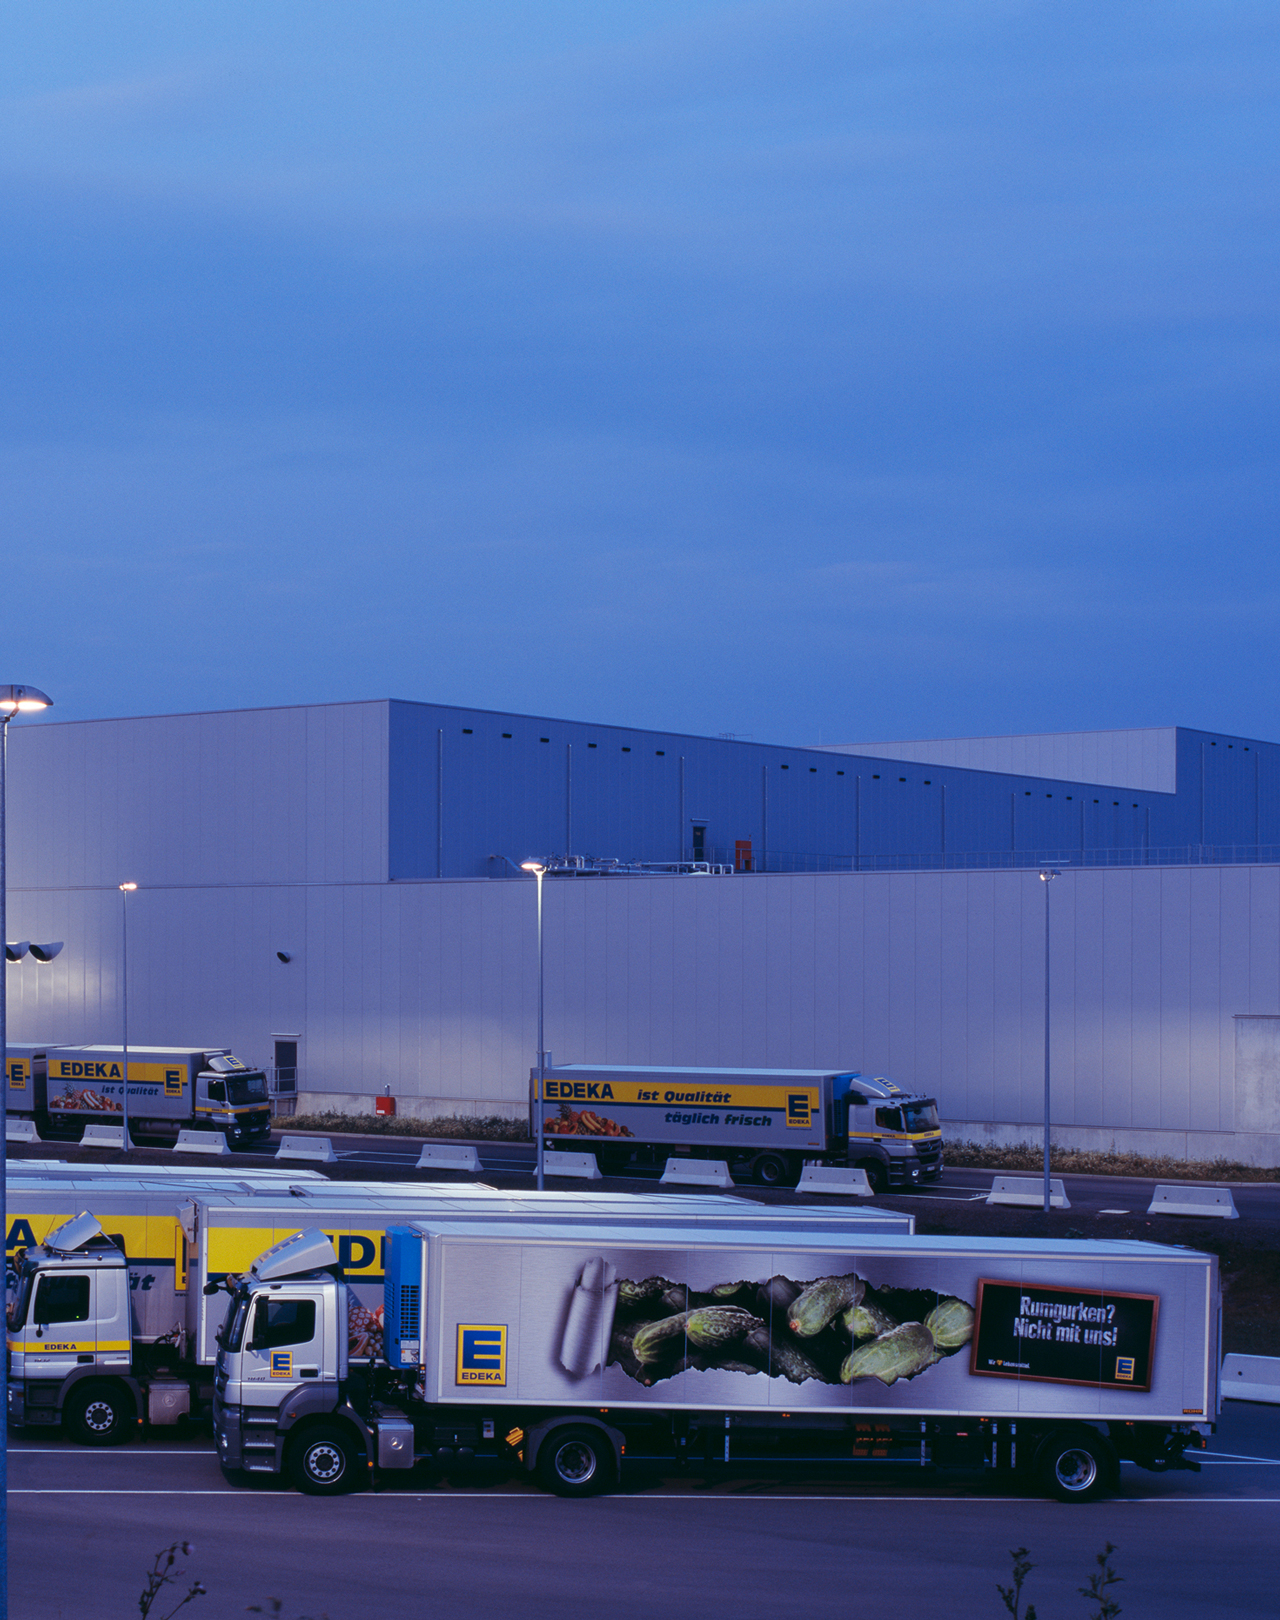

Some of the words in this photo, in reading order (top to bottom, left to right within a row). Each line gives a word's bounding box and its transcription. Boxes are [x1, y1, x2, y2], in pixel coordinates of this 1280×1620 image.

[11, 1064, 23, 1081] E
[60, 1062, 122, 1078] EDEKA
[166, 1070, 180, 1088] E
[102, 1085, 116, 1094] ist
[545, 1082, 614, 1099] EDEKA
[637, 1089, 660, 1101] ist
[664, 1091, 732, 1103] Qualität
[788, 1094, 808, 1118] E
[665, 1112, 720, 1125] täglich
[724, 1114, 772, 1126] frisch
[1020, 1296, 1116, 1324] Rumgurken?
[1013, 1317, 1053, 1340] Nicht
[1056, 1323, 1081, 1344] mit
[1084, 1327, 1118, 1347] uns!
[462, 1330, 501, 1370] E
[273, 1354, 290, 1370] E
[461, 1372, 501, 1380] EDEKA
